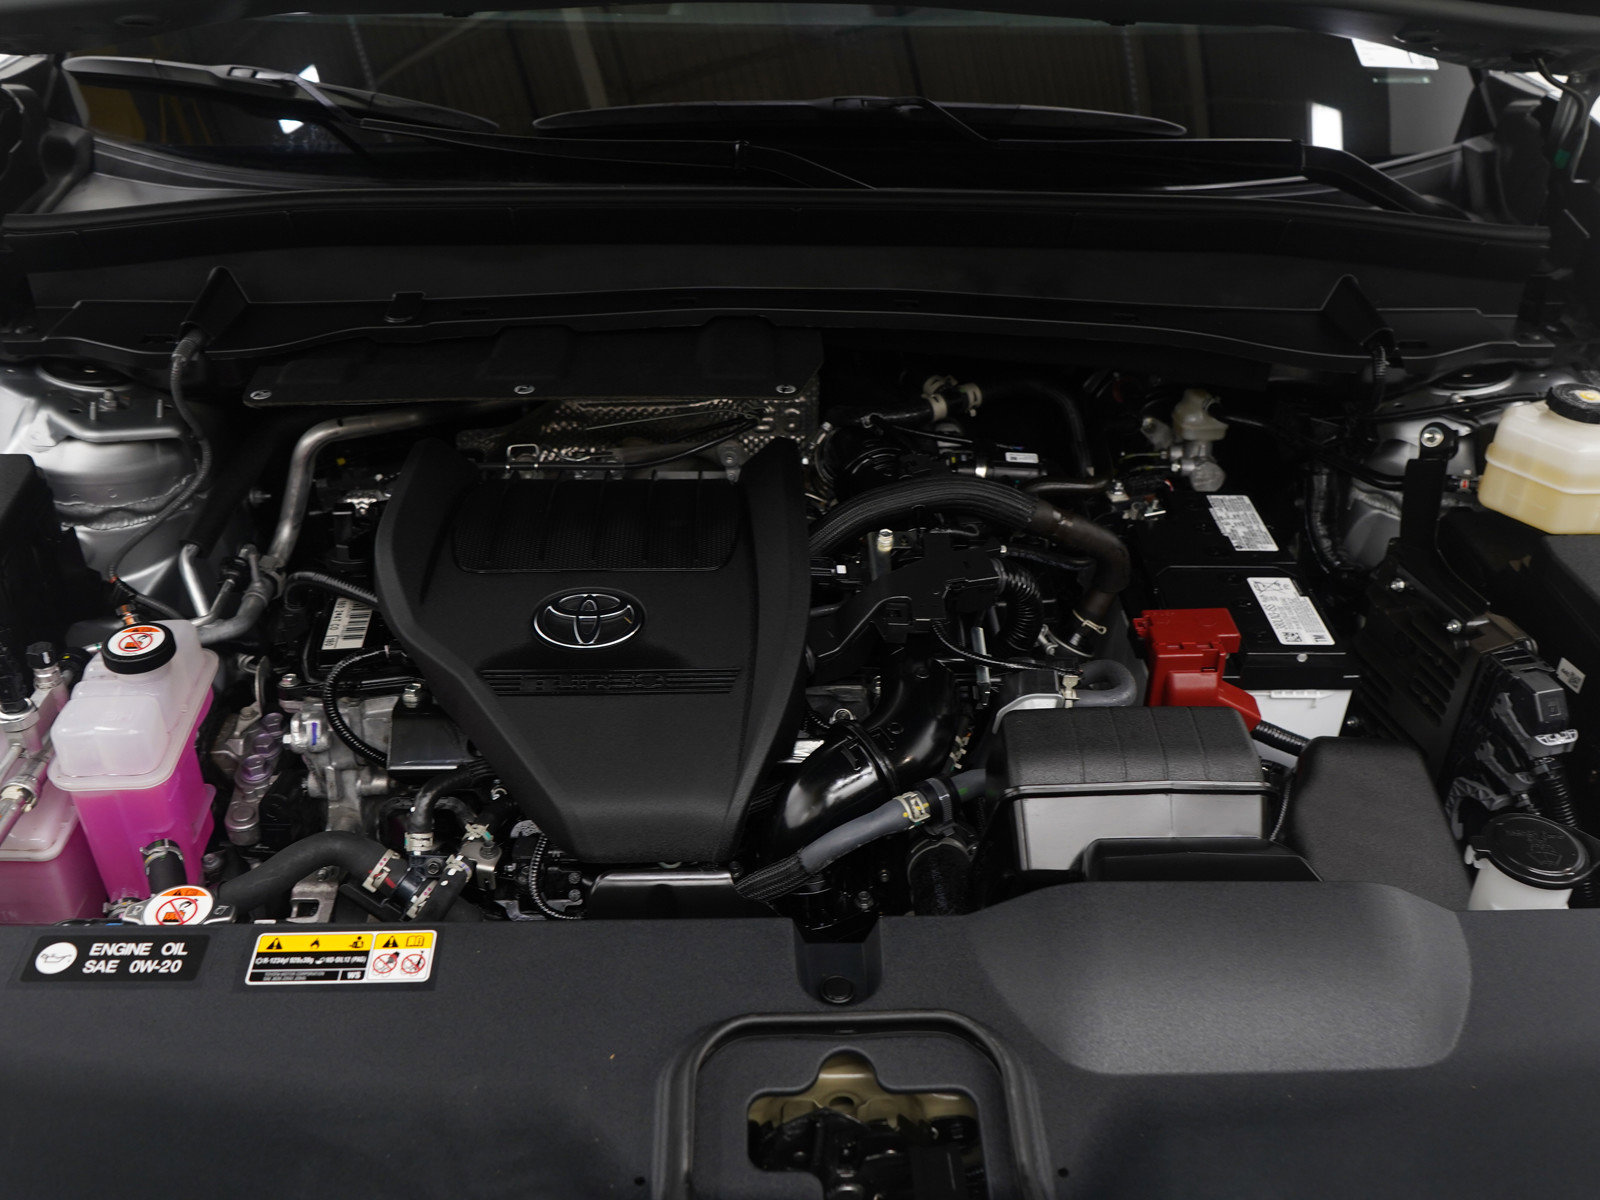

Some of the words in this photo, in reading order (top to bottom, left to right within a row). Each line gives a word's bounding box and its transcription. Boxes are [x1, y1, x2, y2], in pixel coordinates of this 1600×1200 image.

[88, 942, 153, 956] ENGINE
[160, 942, 188, 956] OIL
[82, 959, 120, 974] SAE
[128, 959, 183, 974] 0W-20
